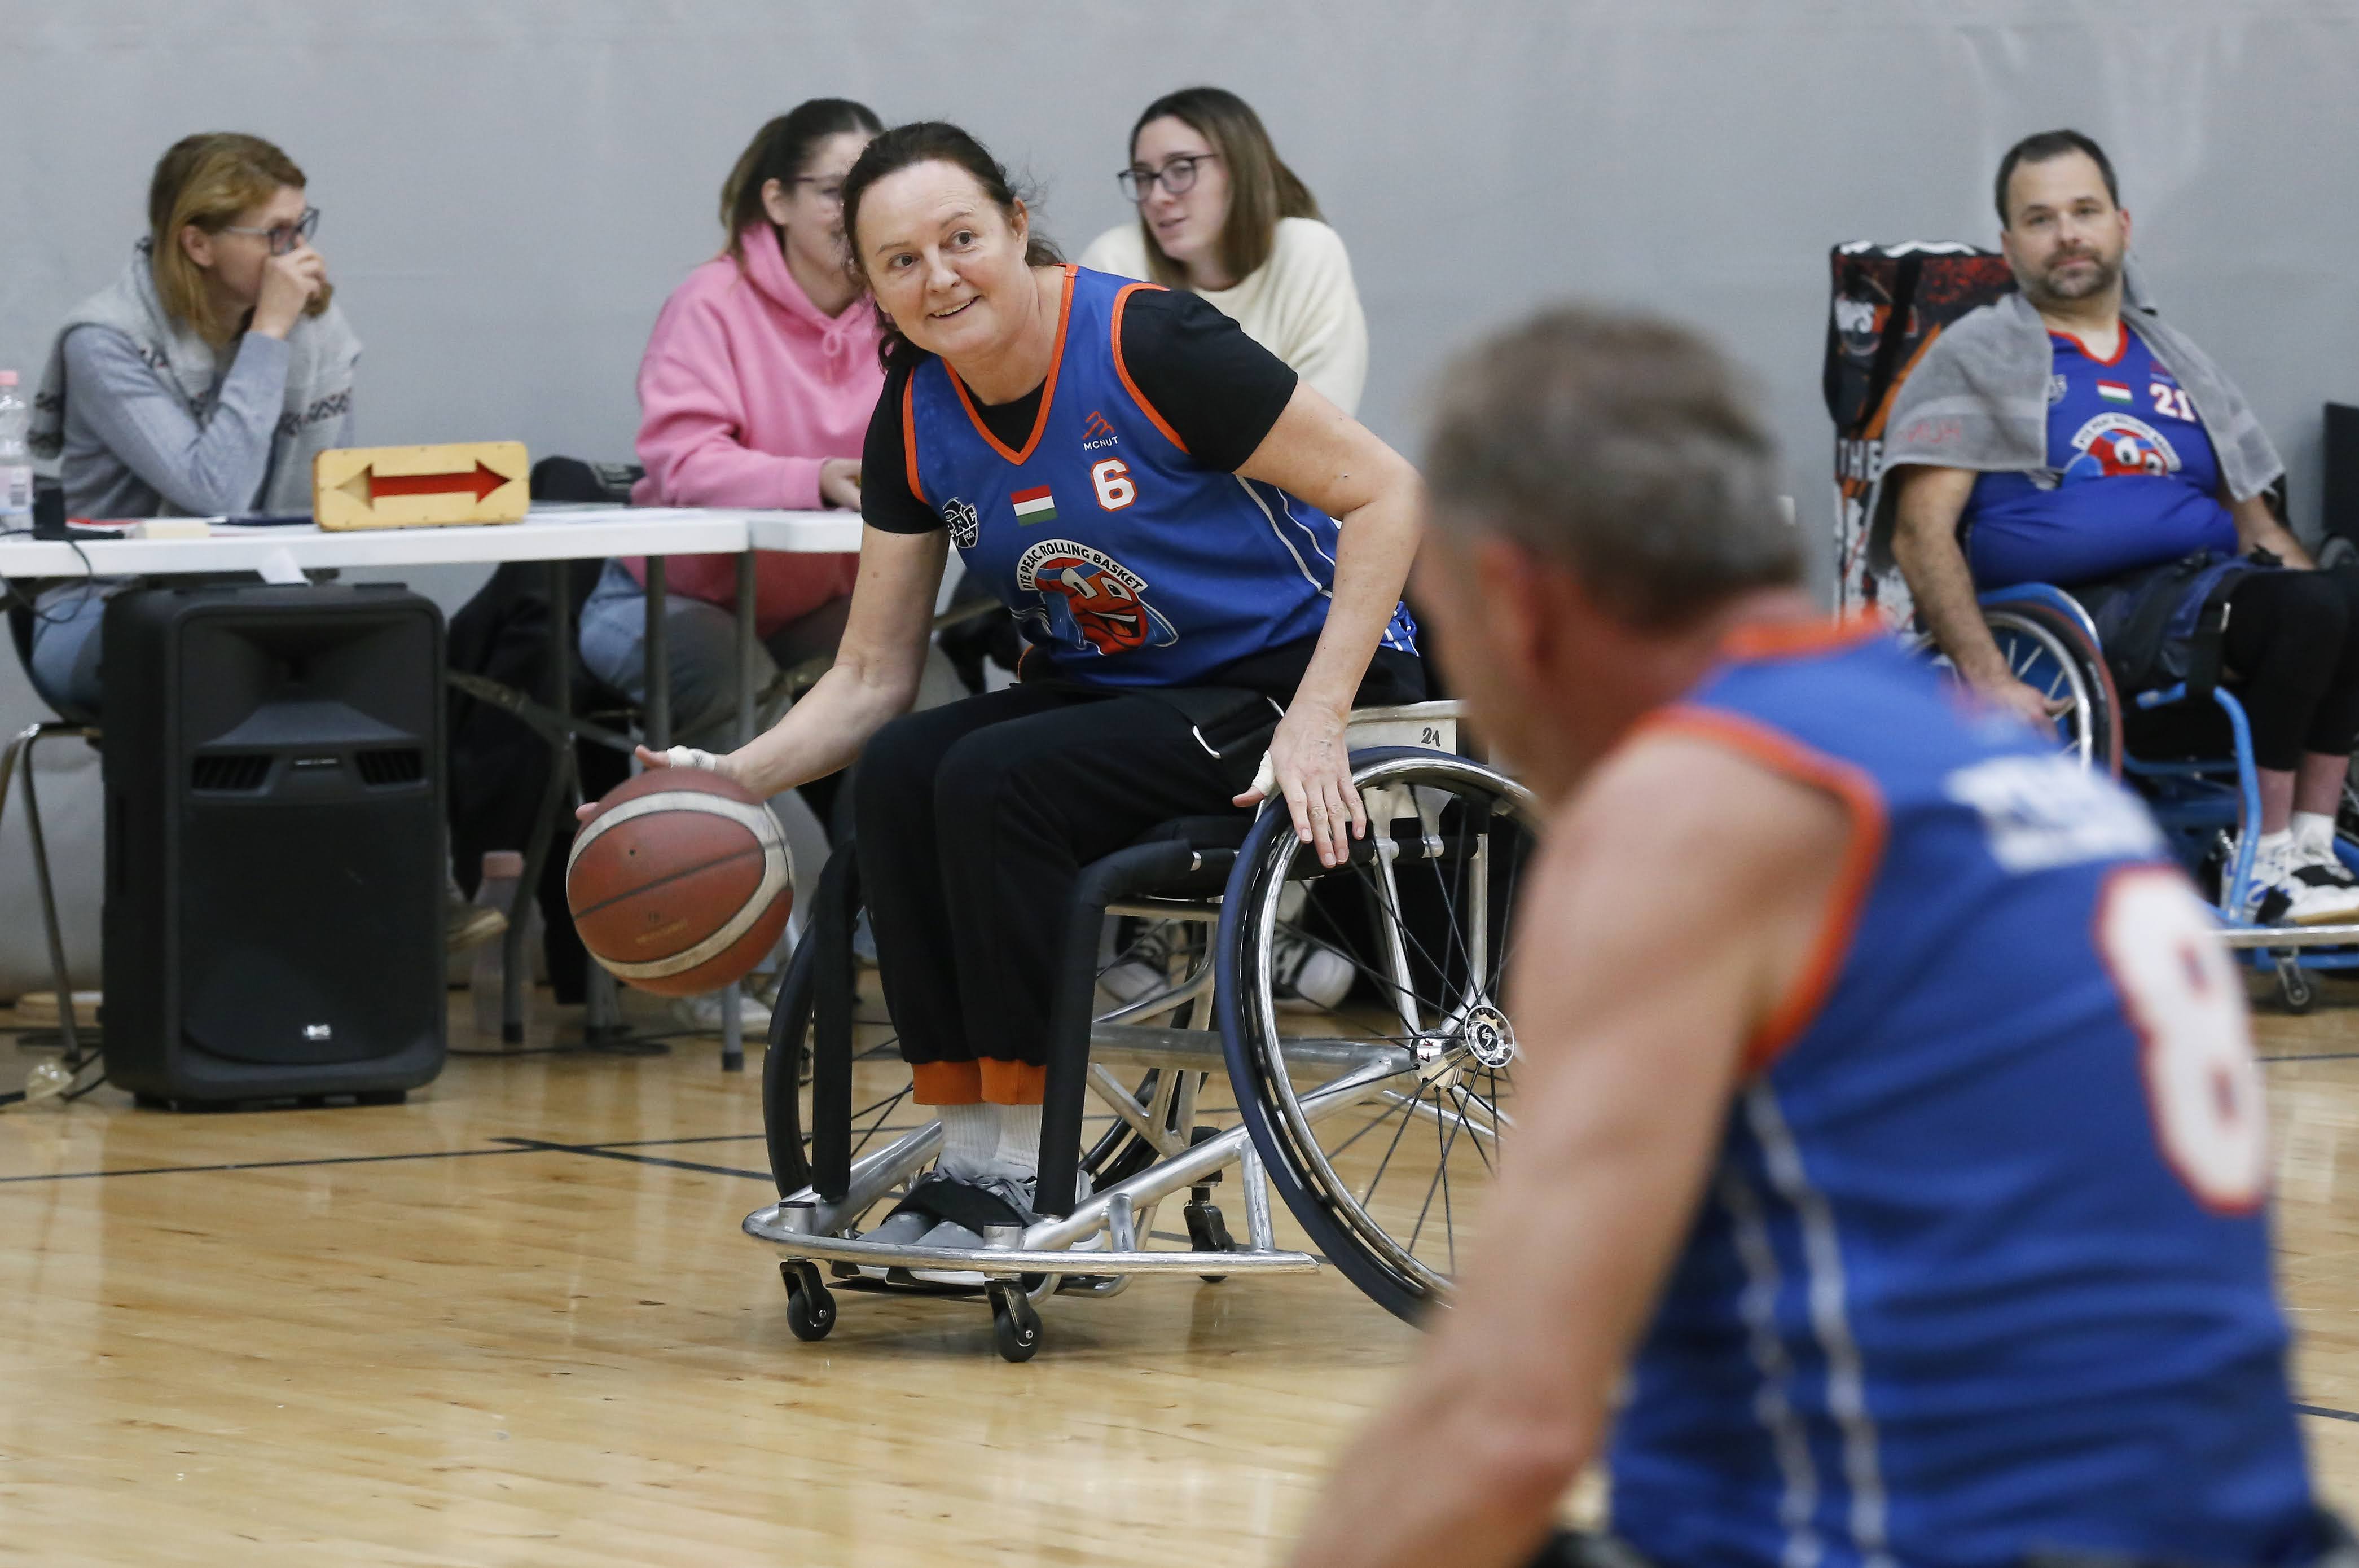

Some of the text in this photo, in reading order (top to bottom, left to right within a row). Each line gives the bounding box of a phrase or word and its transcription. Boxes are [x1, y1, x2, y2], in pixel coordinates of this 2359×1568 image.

[2149, 382, 2196, 422] 21
[1083, 436, 1118, 451] MCNUT
[1091, 457, 1138, 512] 6
[1020, 542, 1143, 590] PTE PEAC ROLLING BASKET
[1421, 727, 1440, 748] 21
[2091, 862, 2268, 1217] 8
